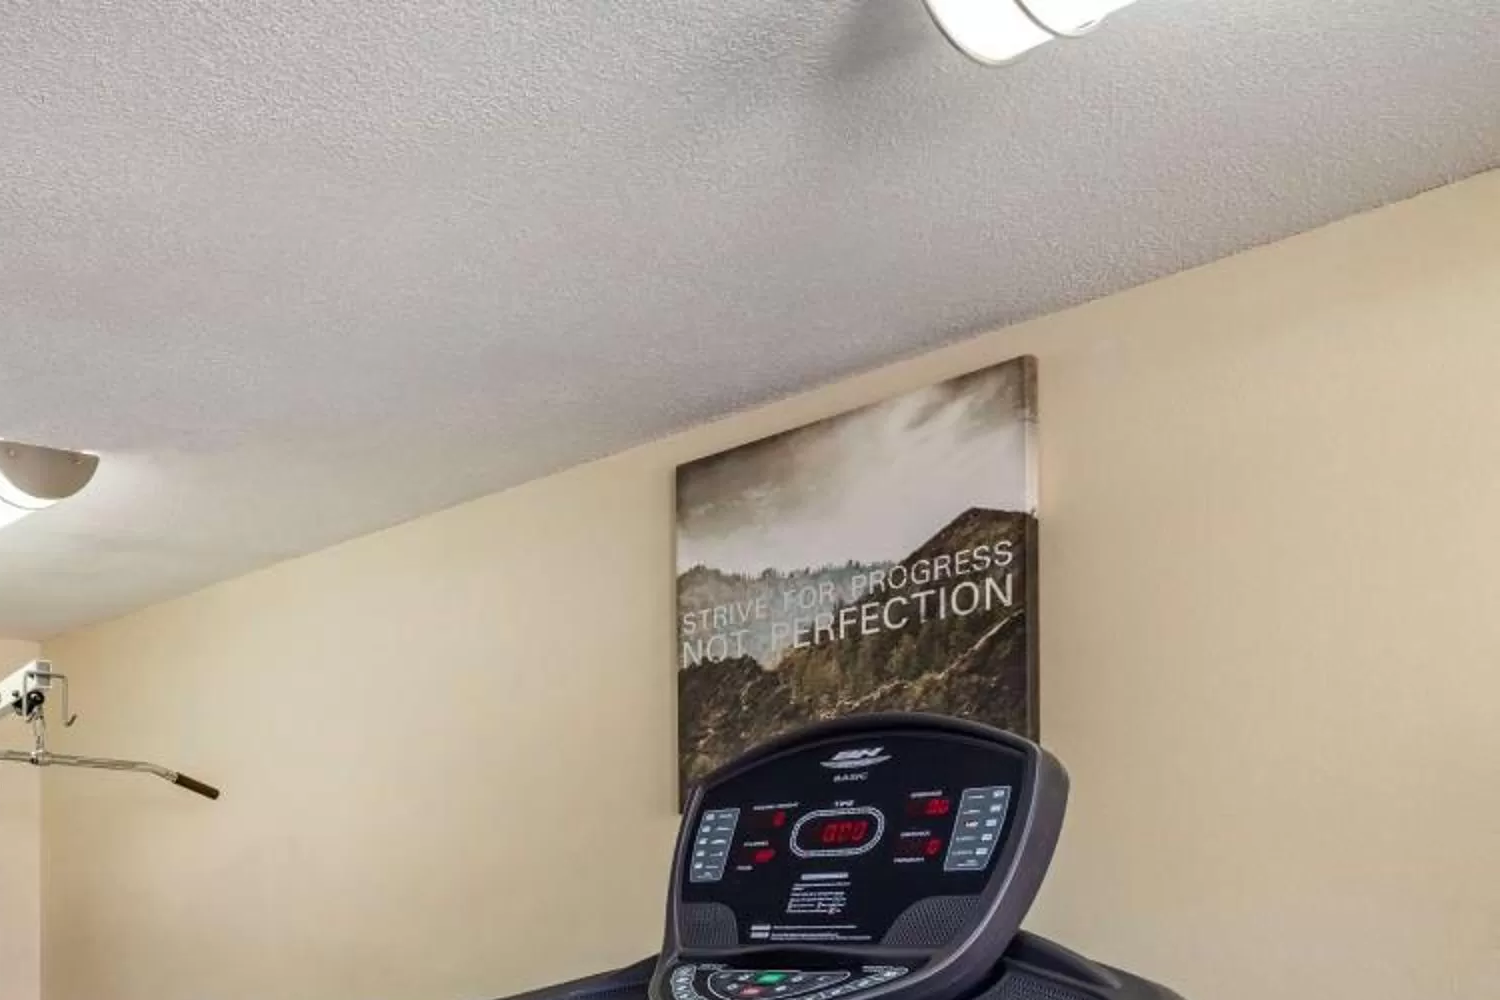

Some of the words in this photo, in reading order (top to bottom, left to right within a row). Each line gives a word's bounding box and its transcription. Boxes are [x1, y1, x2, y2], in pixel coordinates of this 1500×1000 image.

[683, 599, 768, 635] STRIVE
[783, 581, 837, 611] FOR
[851, 540, 1013, 598] PROGRESS
[683, 630, 749, 668] NOT
[771, 573, 1014, 652] PERFECTION
